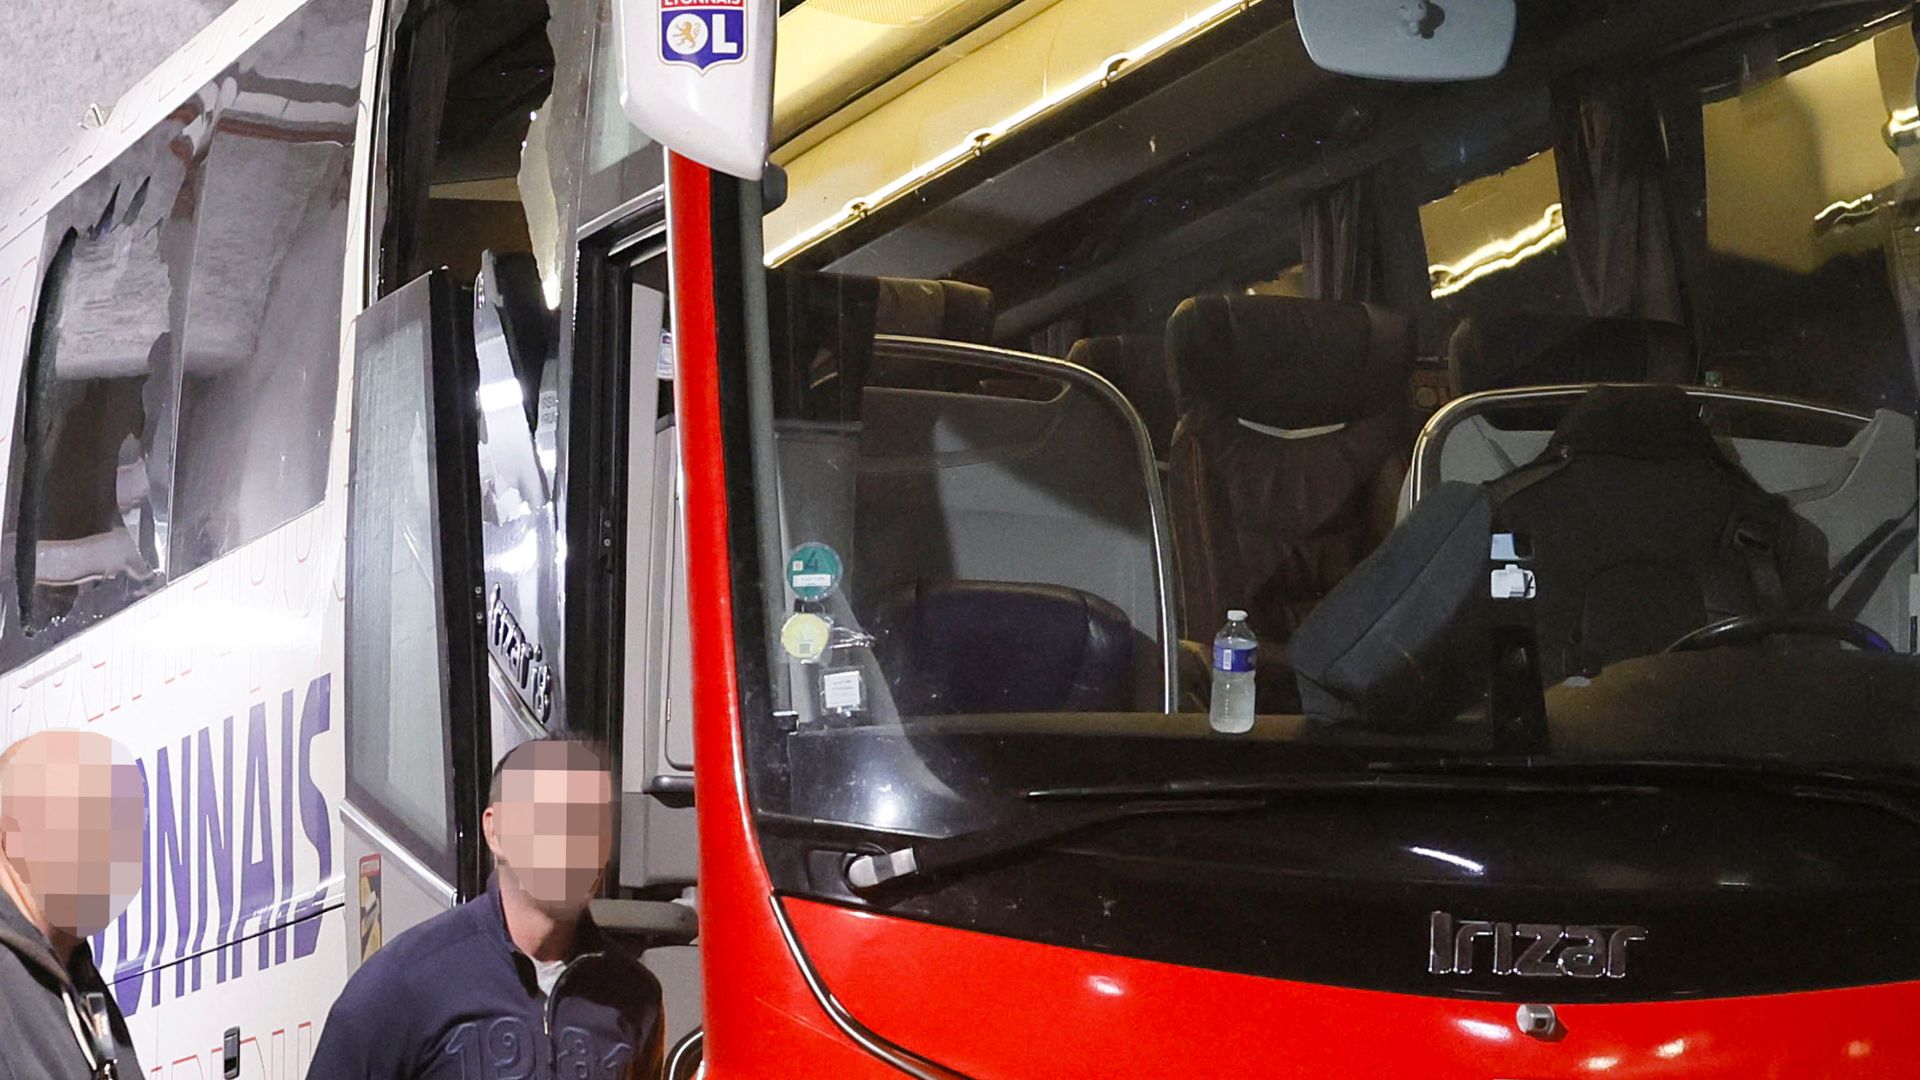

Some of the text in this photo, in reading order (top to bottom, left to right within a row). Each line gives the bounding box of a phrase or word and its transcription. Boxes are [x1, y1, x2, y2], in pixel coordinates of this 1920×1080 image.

[666, 13, 738, 54] OL
[1429, 910, 1648, 978] Irizar
[445, 1016, 632, 1080] 1981
